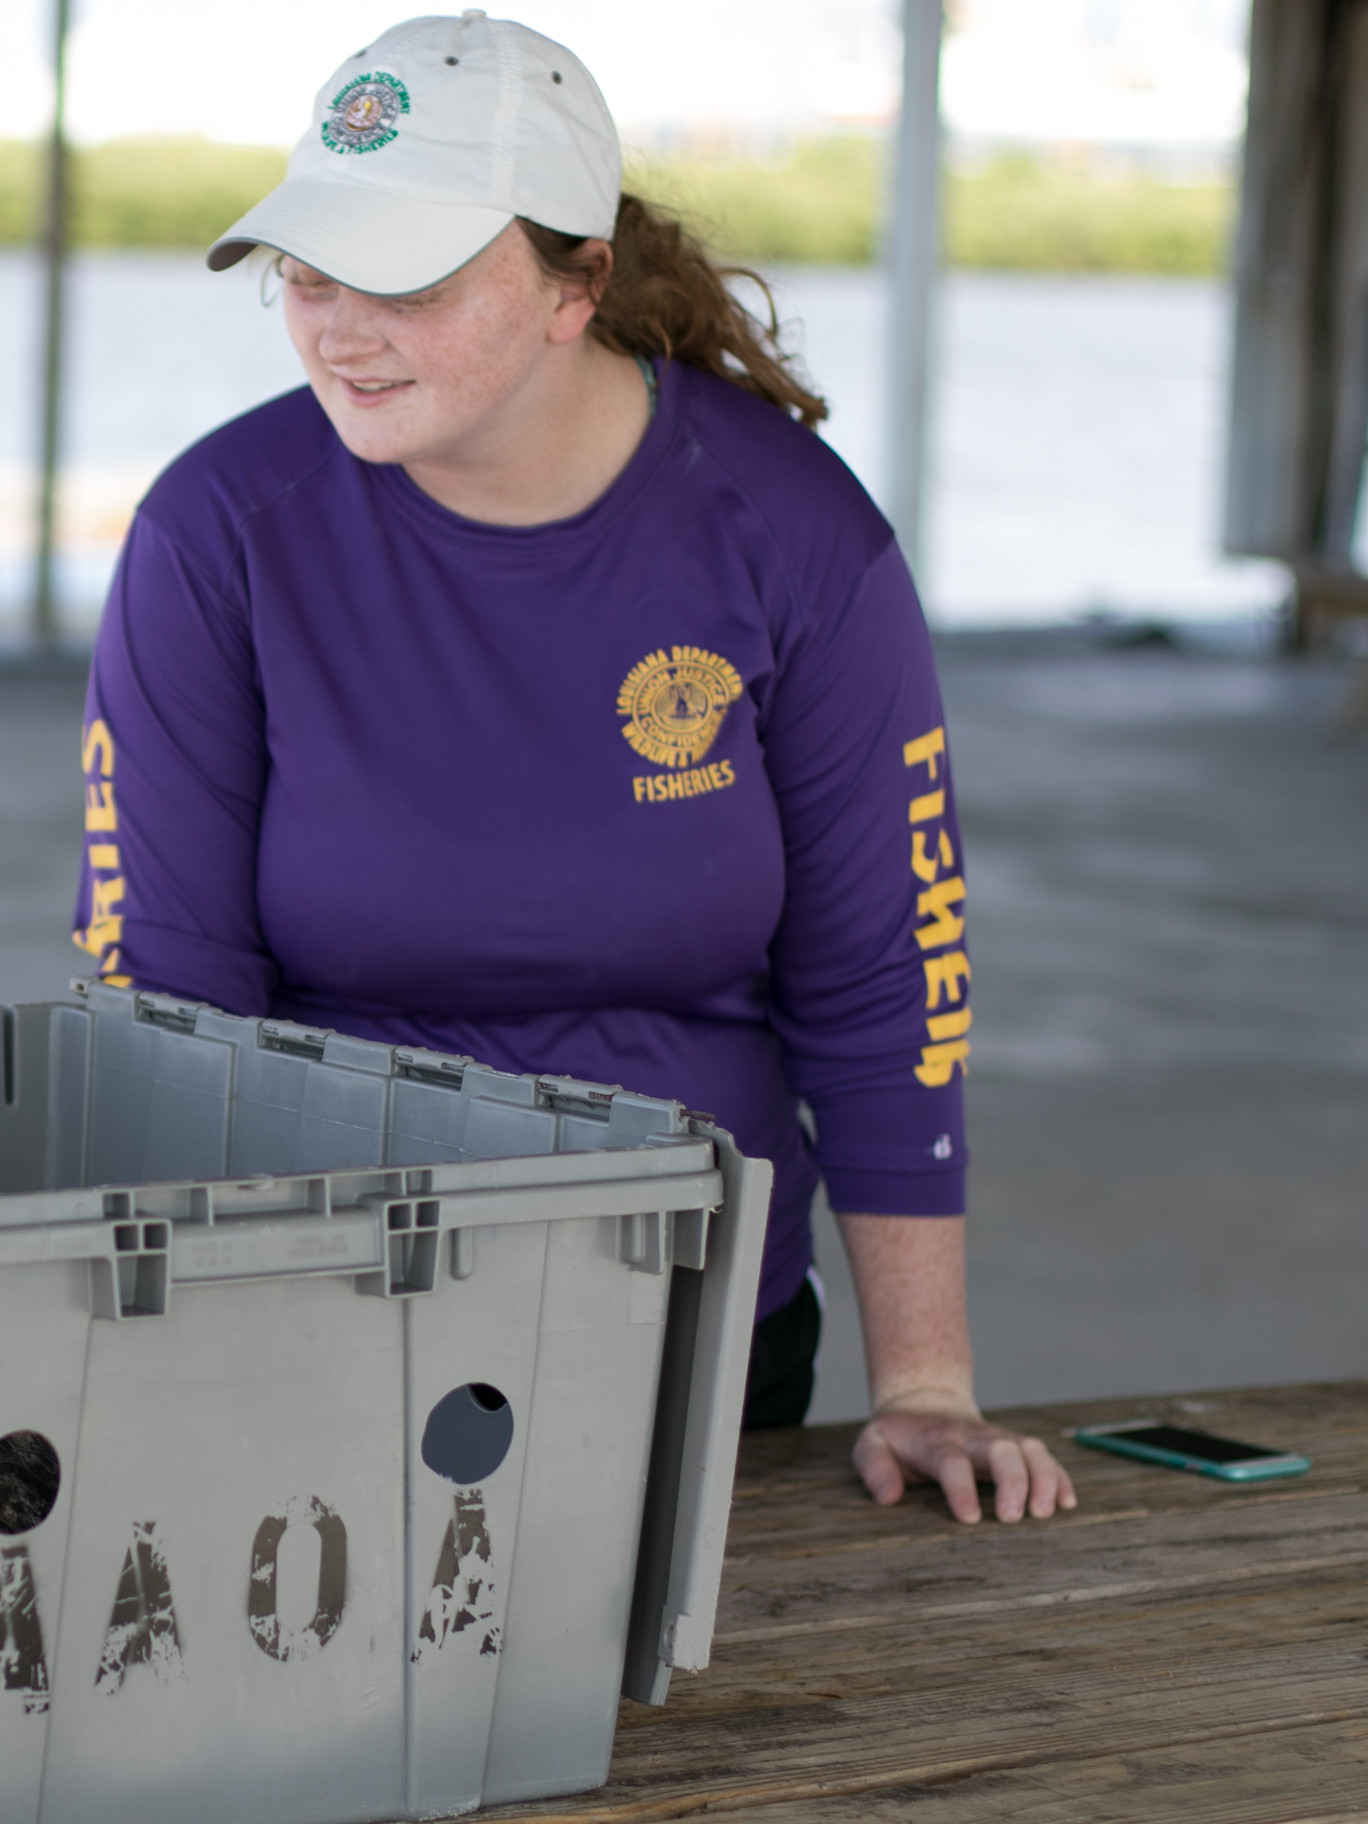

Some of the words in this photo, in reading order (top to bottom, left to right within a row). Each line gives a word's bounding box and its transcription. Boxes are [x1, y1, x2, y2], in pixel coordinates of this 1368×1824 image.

[616, 648, 669, 715] LOUISIANA
[639, 671, 670, 715] UNION
[673, 667, 725, 706] JUSTICE
[621, 721, 677, 768] WILDLIFE
[632, 759, 735, 802] FISHERIES
